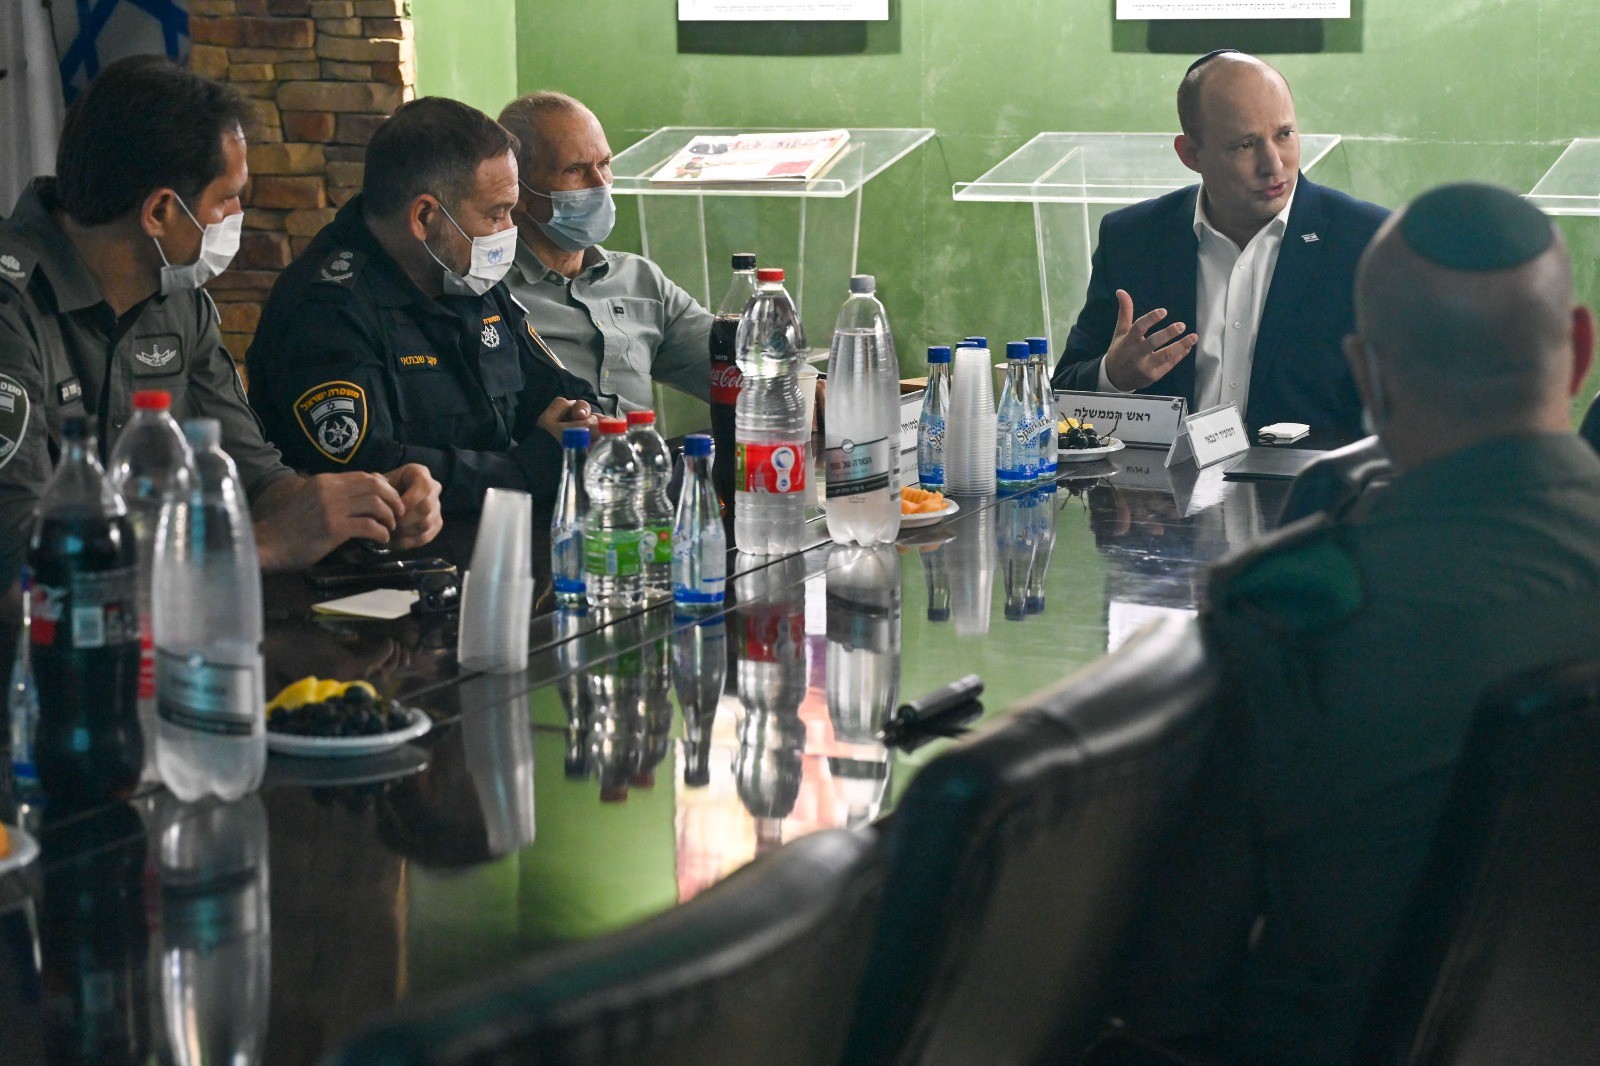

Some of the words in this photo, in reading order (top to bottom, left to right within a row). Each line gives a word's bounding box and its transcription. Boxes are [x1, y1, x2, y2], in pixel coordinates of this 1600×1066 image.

[327, 387, 360, 399] משטרת
[1073, 406, 1123, 420] הממשלה
[1126, 411, 1151, 422] ראש
